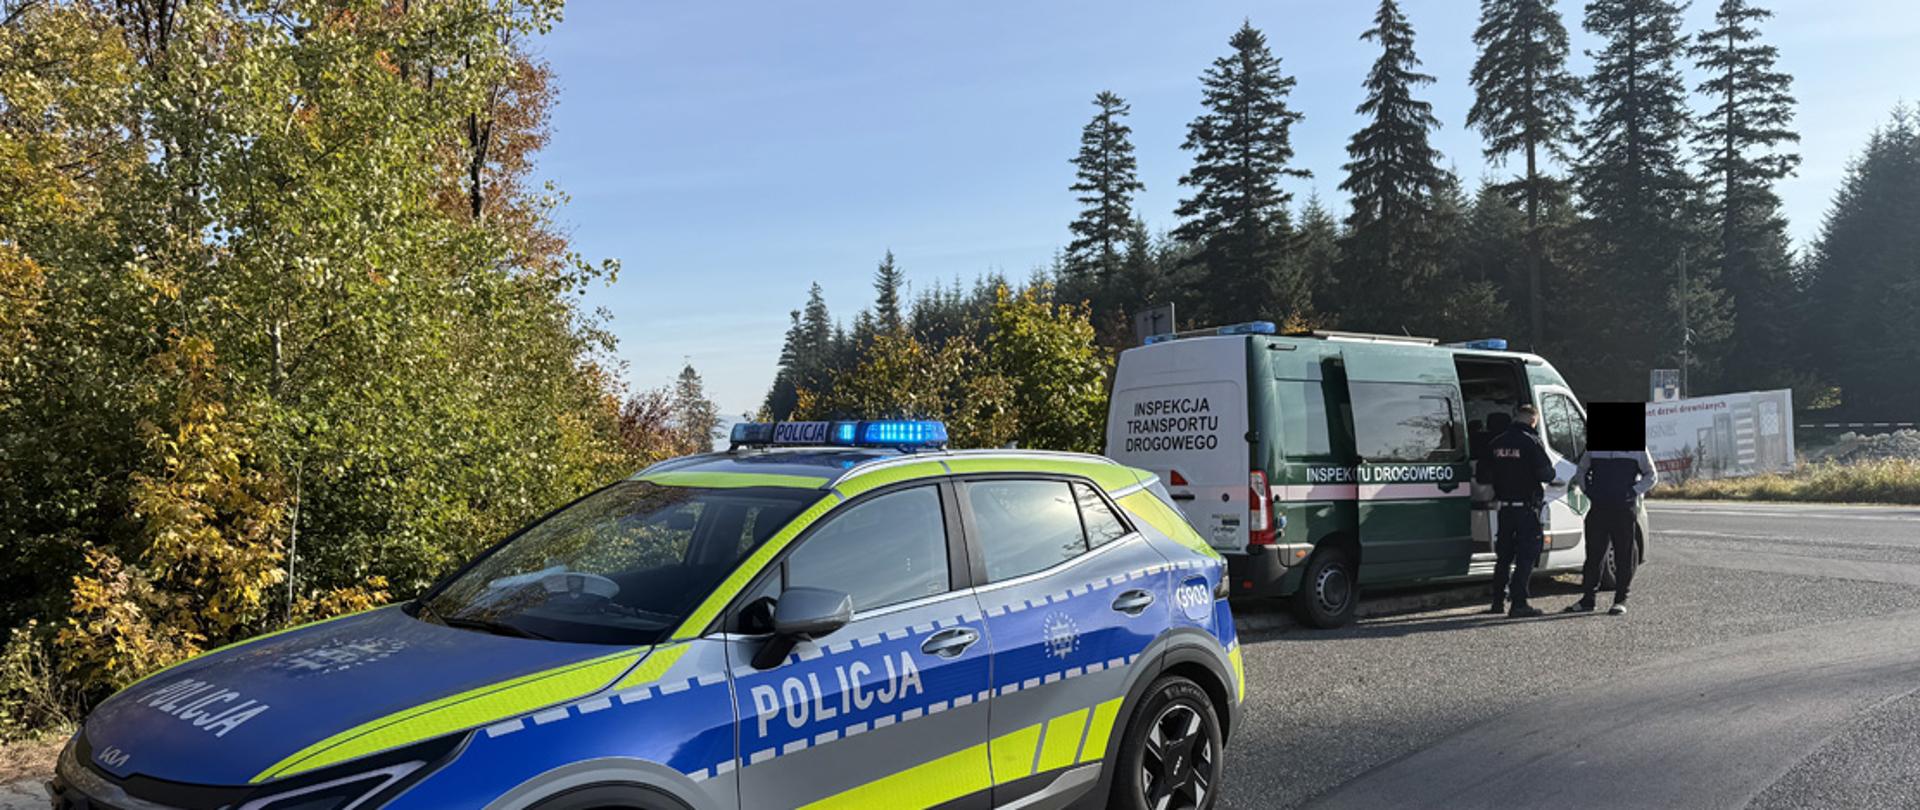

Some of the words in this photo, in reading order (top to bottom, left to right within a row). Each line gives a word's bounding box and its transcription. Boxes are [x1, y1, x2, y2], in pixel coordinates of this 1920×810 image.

[1134, 398, 1210, 416] INSPEKCJA
[775, 422, 827, 442] POLICJA
[1126, 416, 1218, 434] TRANSPORTU
[1125, 435, 1218, 452] DROGOWEGO
[1374, 466, 1454, 482] DROGOWEGO
[751, 650, 925, 738] POLICJA
[136, 678, 271, 738] POLICJA
[98, 745, 131, 768] KIA
